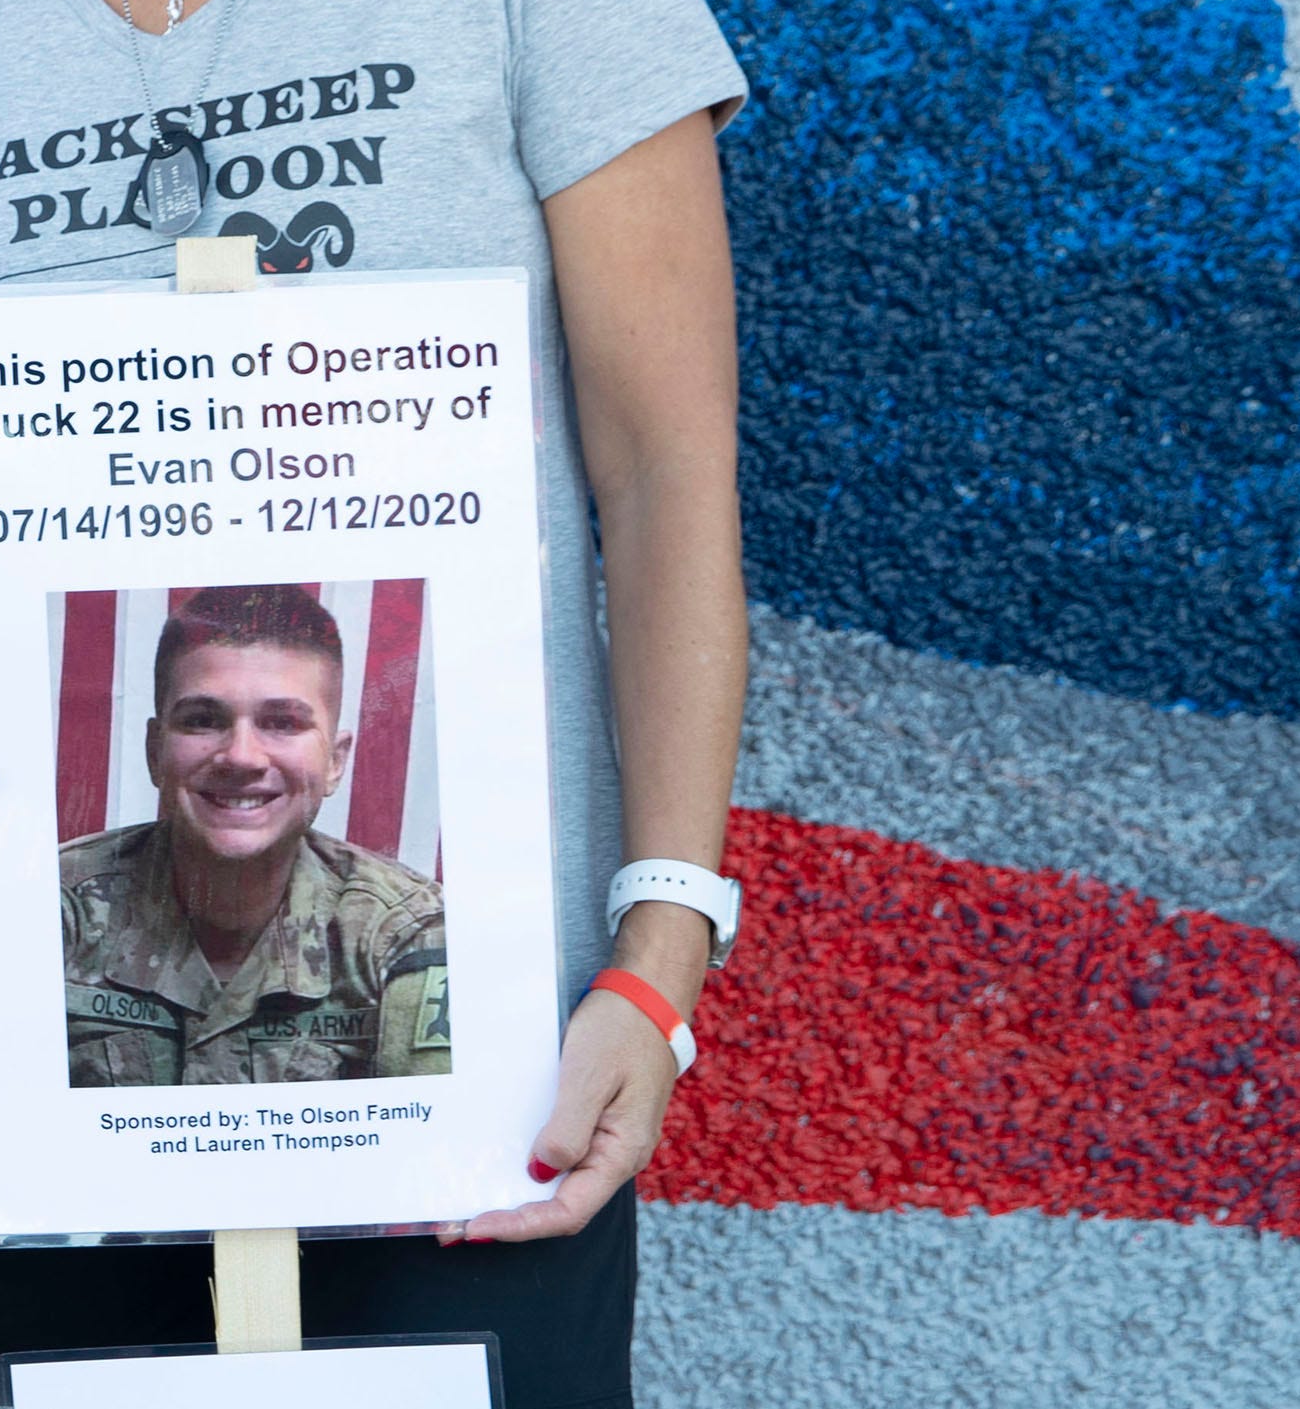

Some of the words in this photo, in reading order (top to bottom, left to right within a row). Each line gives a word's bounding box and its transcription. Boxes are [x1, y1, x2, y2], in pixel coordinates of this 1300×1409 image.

[62, 348, 214, 392] portion
[232, 343, 273, 377] of
[288, 336, 498, 382] Operation
[93, 401, 140, 435] 22
[157, 400, 191, 432] is
[208, 398, 243, 430] in
[261, 397, 434, 431] memory
[451, 386, 492, 420] of
[109, 453, 213, 486] Evan
[230, 448, 354, 481] Olson
[258, 491, 480, 532] 12/12/2020
[91, 994, 159, 1022] OLSON
[309, 1013, 366, 1038] ARMY
[101, 1111, 211, 1133] Sponsored
[219, 1111, 248, 1131] by:
[256, 1109, 294, 1125] The
[301, 1108, 359, 1124] Olson
[367, 1102, 432, 1122] Family
[151, 1137, 187, 1153] and
[195, 1136, 265, 1152] Lauren
[272, 1134, 379, 1152] Thompson
